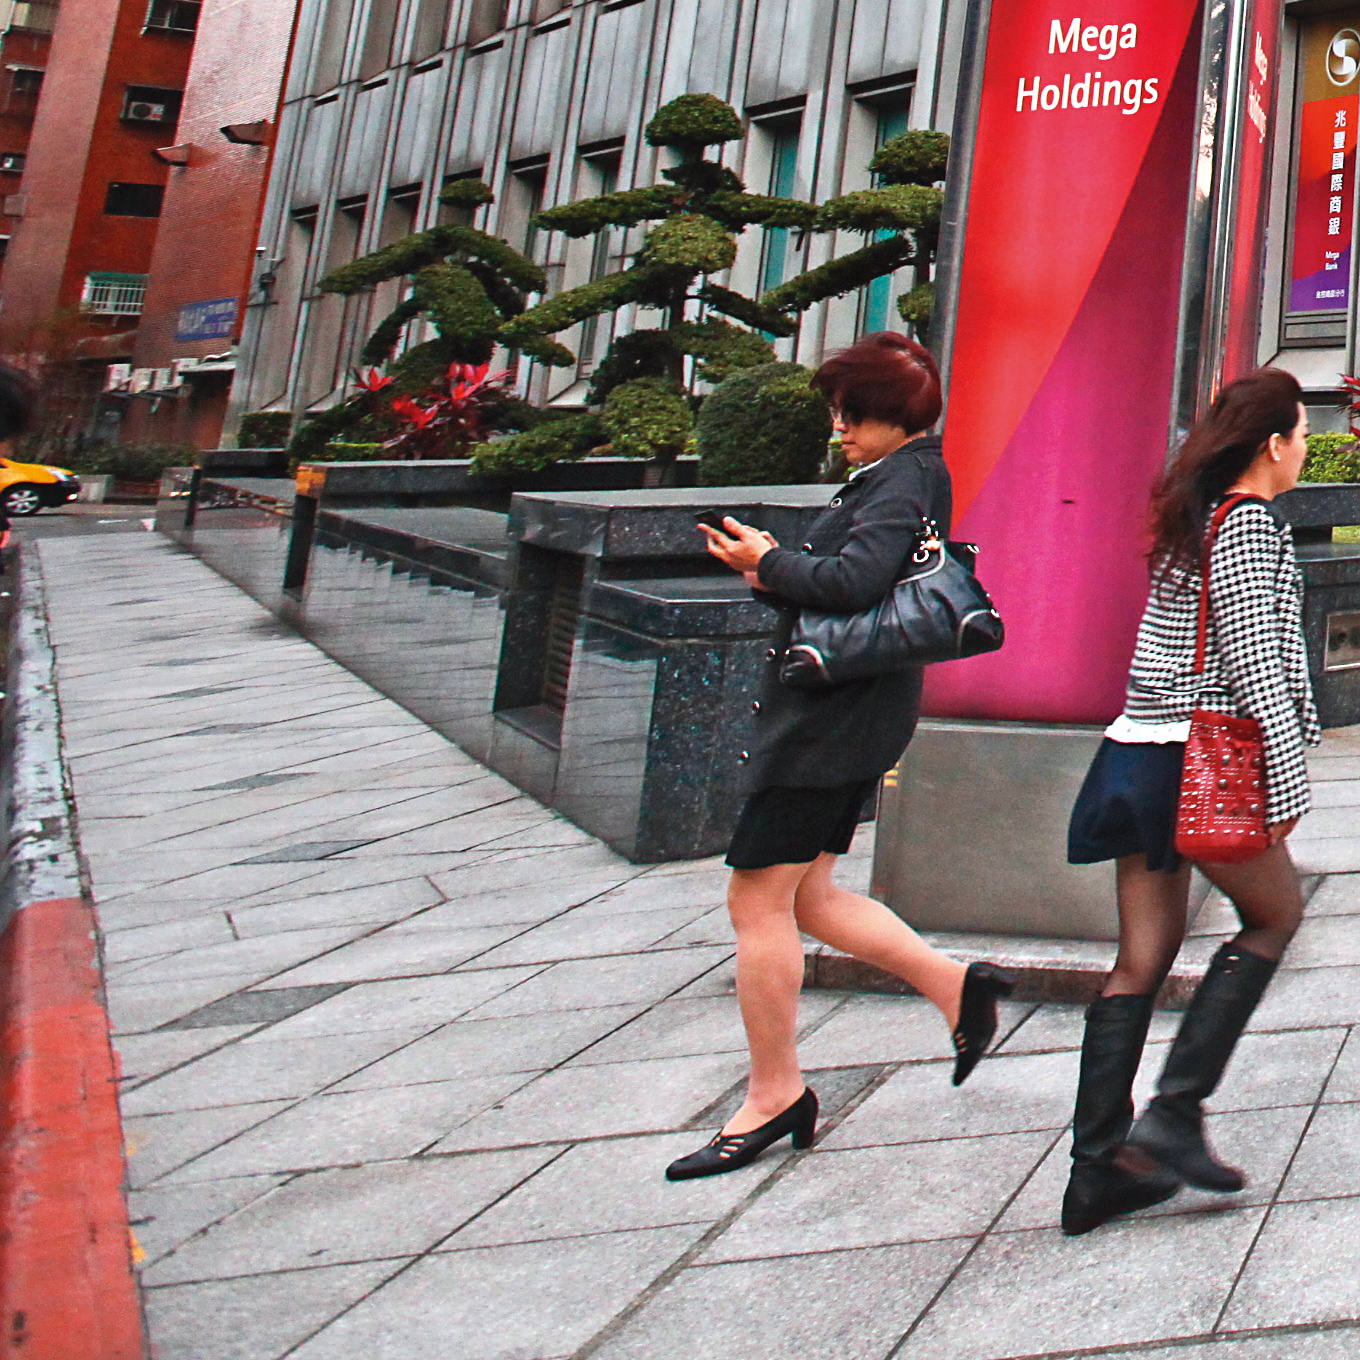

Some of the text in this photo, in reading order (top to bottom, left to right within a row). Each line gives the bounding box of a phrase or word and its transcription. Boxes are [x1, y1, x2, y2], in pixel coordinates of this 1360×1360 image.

[1048, 17, 1137, 61] Mega
[1016, 71, 1159, 115] Holdings
[1327, 109, 1347, 235] 兆豐國際商銀
